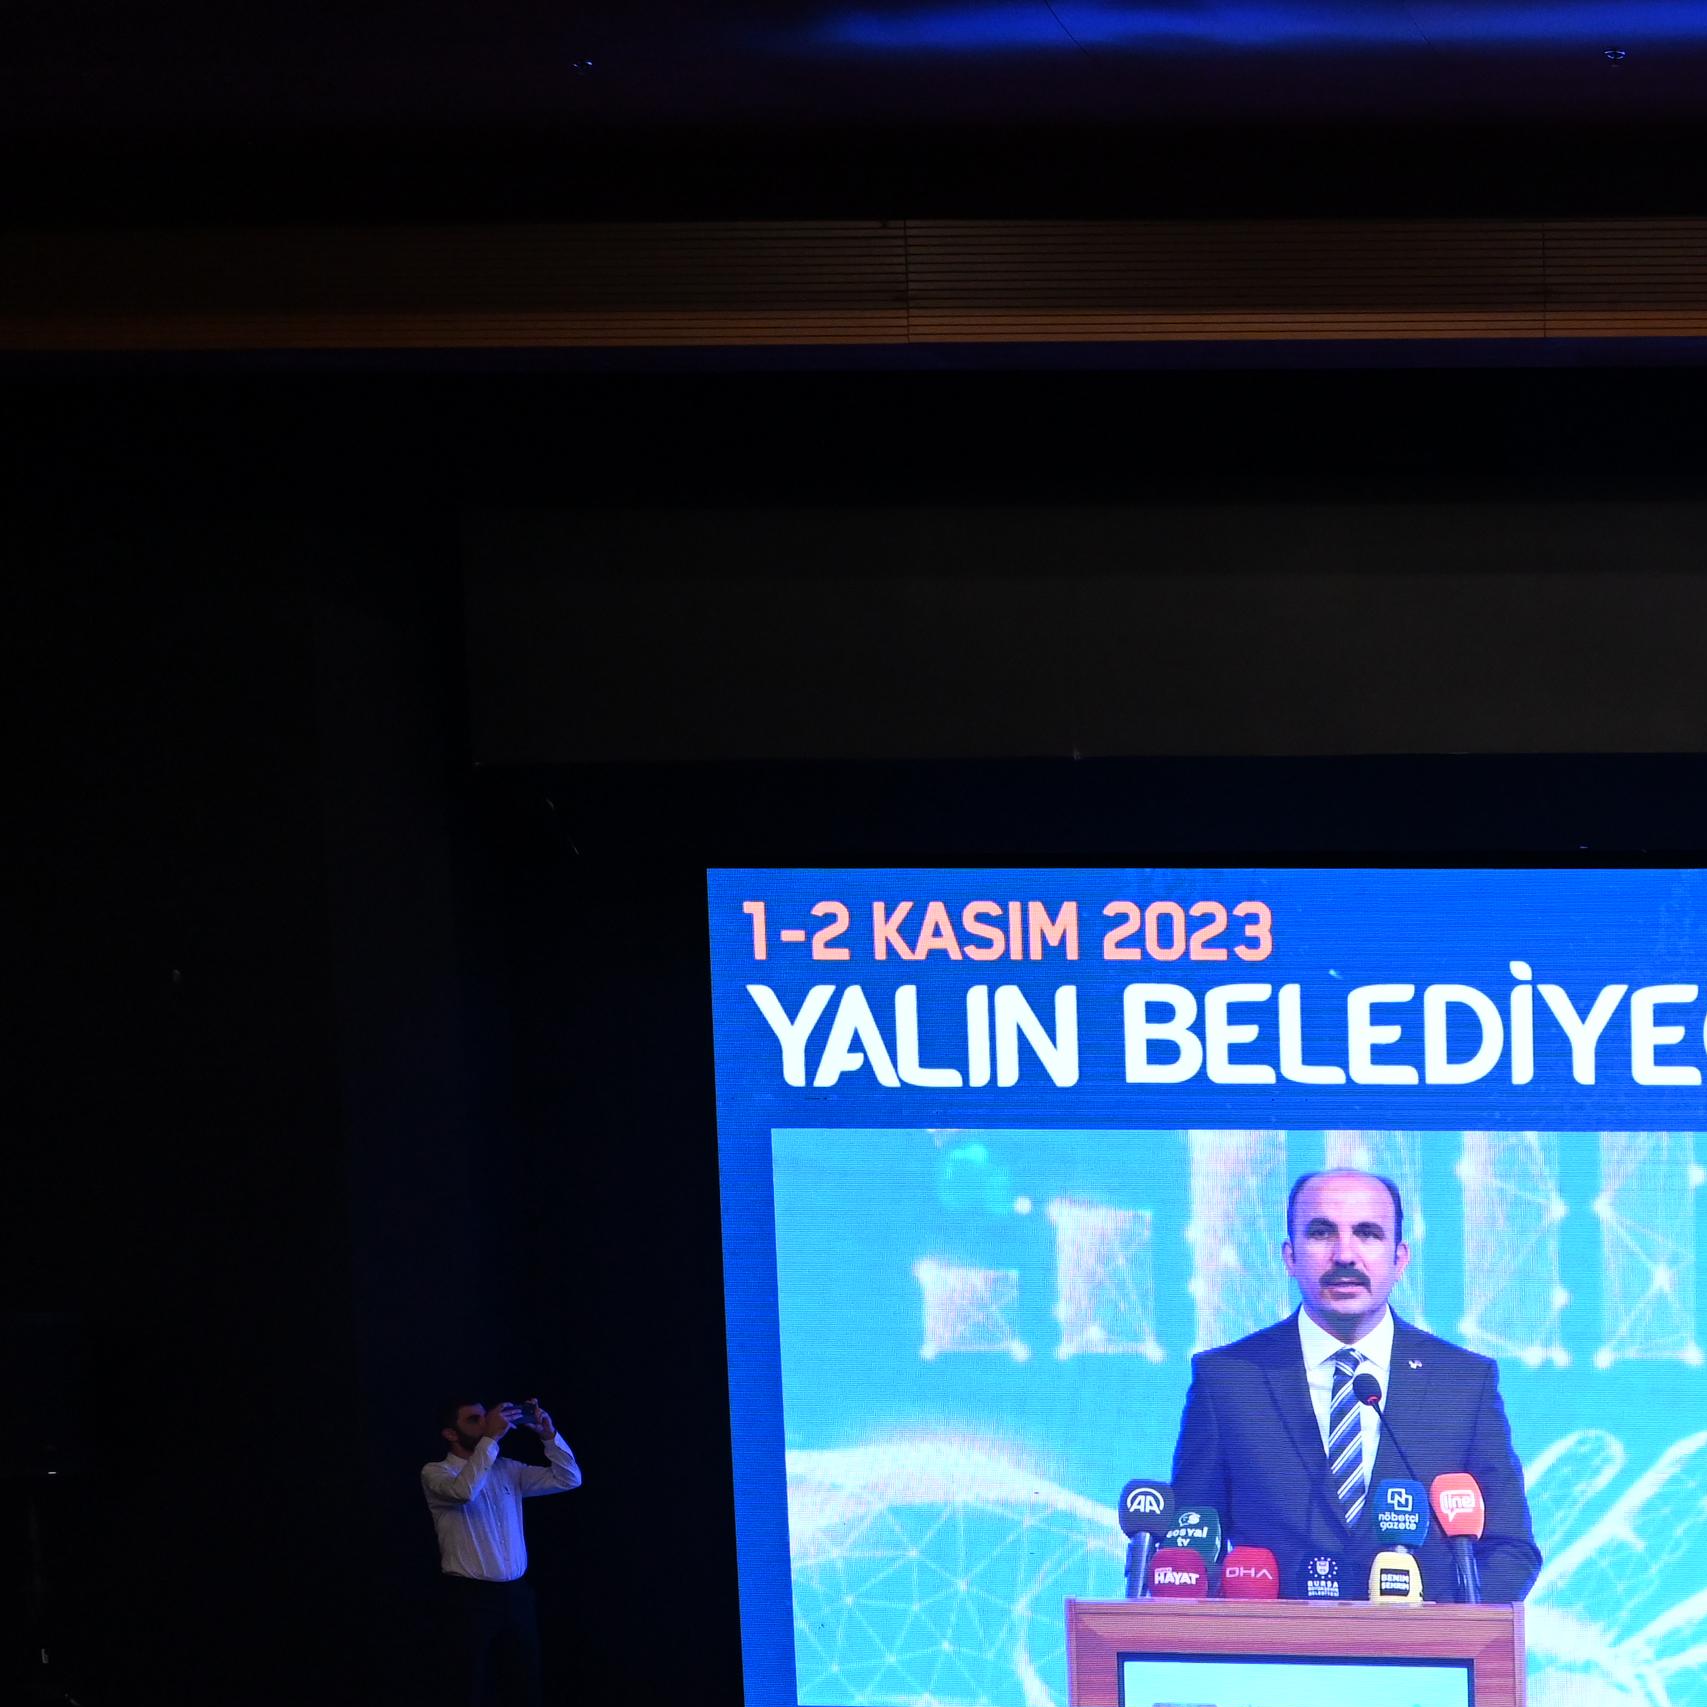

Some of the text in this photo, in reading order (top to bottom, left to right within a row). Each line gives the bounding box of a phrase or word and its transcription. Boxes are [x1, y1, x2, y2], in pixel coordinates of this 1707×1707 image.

[743, 900, 1273, 962] 1-2 KASIM 2023
[746, 984, 1079, 1088] YALIN
